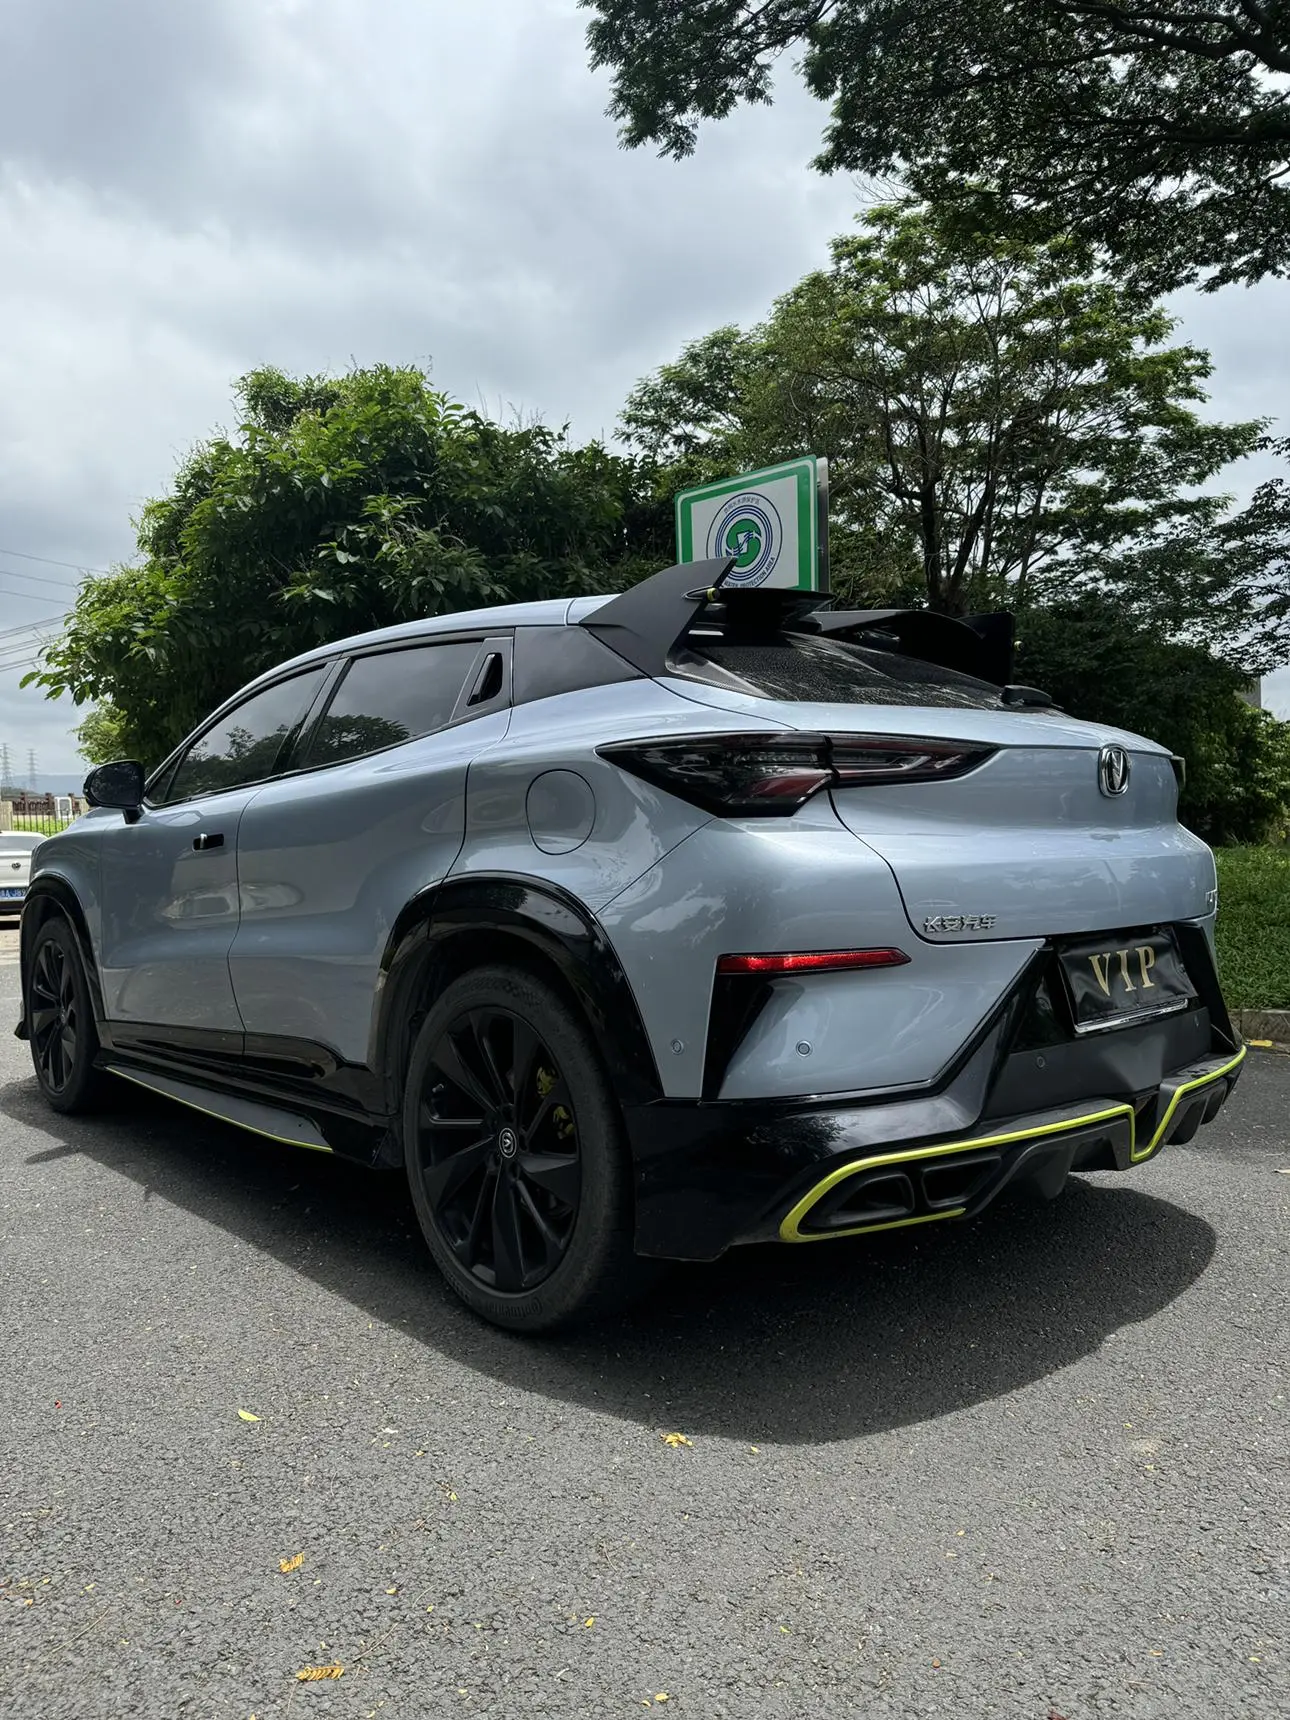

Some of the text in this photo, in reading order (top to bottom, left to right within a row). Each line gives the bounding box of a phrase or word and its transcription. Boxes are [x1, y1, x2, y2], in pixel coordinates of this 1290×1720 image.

[924, 913, 998, 932] 长安汽车
[1088, 945, 1156, 997] VIP
